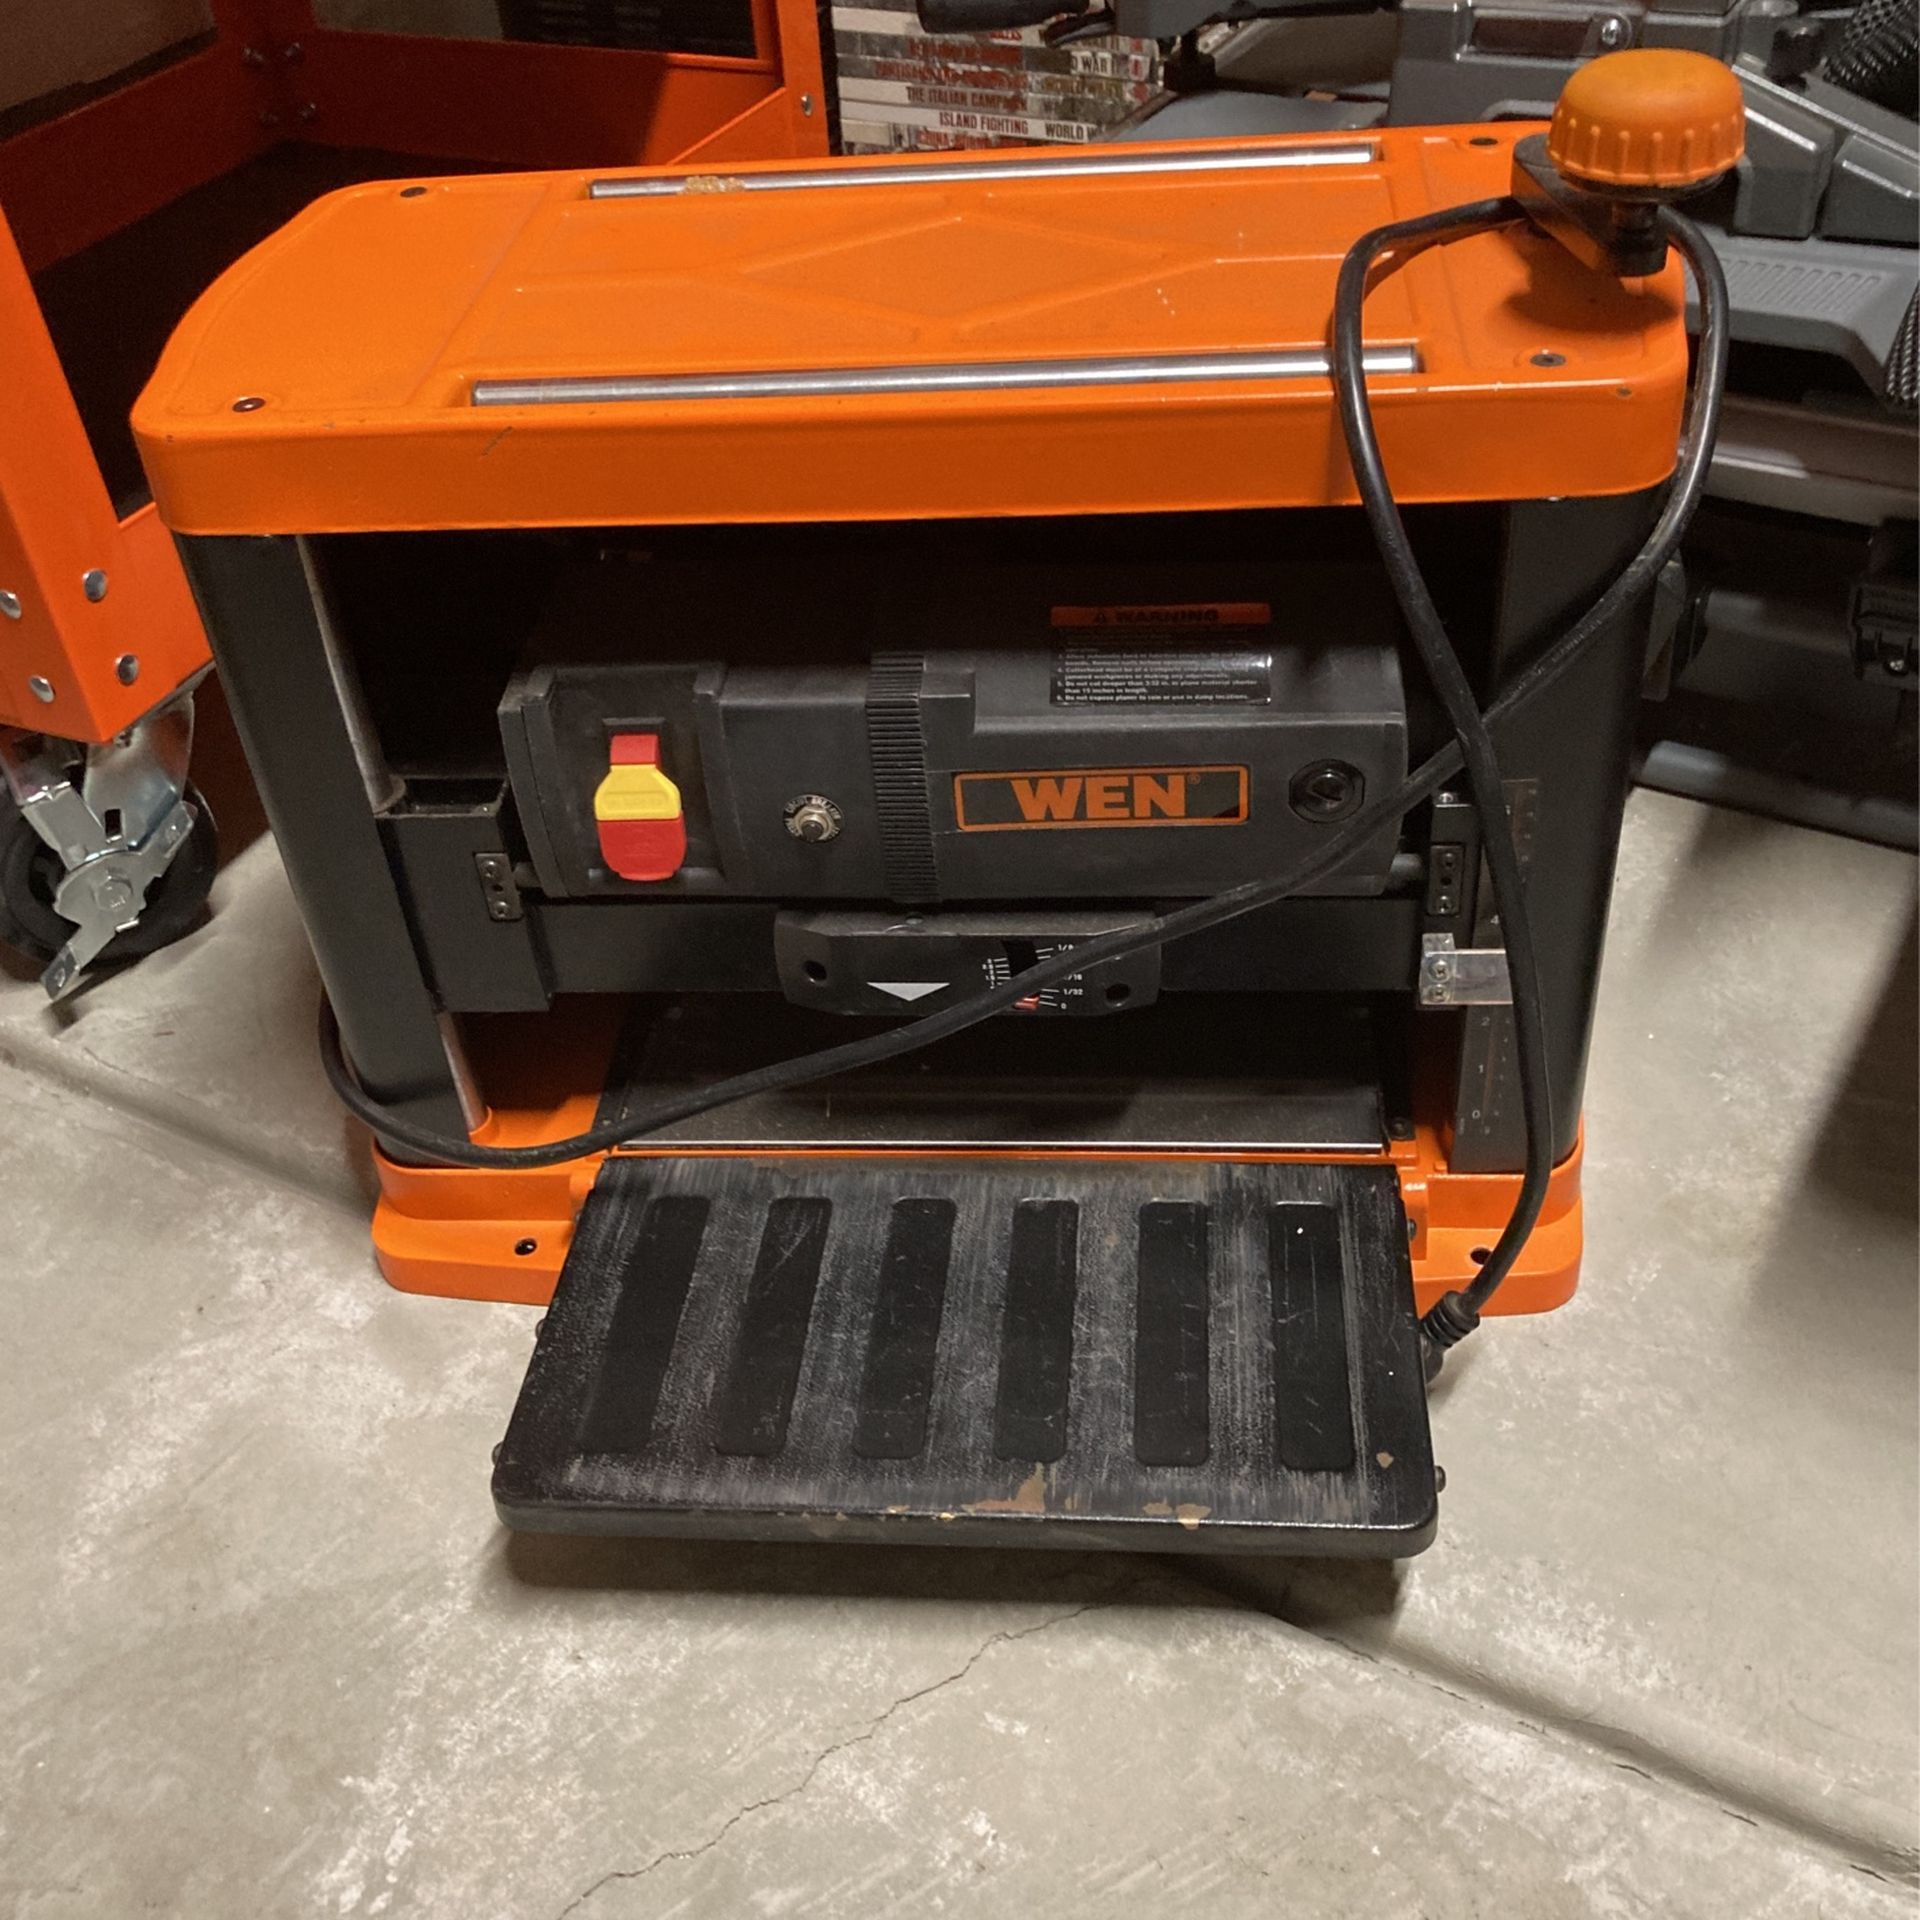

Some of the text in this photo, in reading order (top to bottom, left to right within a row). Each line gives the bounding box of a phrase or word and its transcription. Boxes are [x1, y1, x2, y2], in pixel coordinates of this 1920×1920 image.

[1081, 55, 1108, 74] WAR
[905, 86, 925, 103] THE
[927, 88, 969, 107] ITALIAN
[939, 111, 978, 130] ISLAND
[980, 115, 1029, 135] FIGHTING
[1044, 123, 1084, 141] WORLD
[1010, 774, 1188, 822] WEN
[1063, 988, 1084, 996] 1/32
[1060, 1002, 1068, 1010] 0
[1480, 1015, 1492, 1027] 2
[1477, 1063, 1485, 1074] 1
[1471, 1109, 1481, 1120] 0
